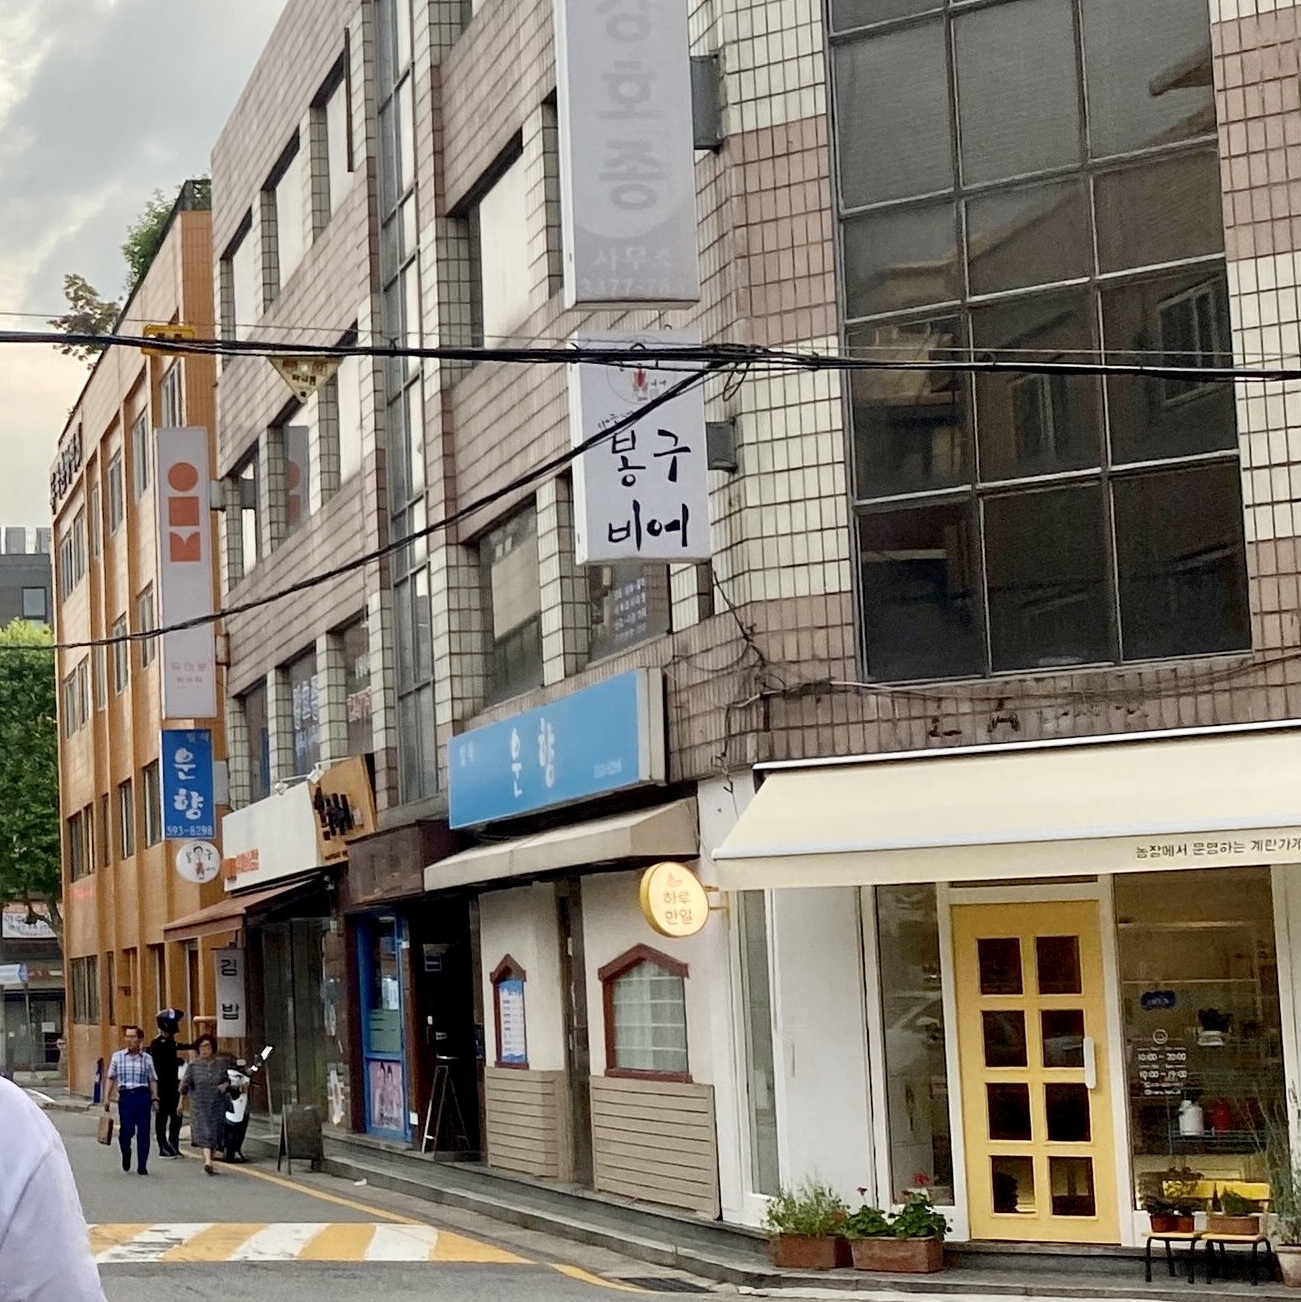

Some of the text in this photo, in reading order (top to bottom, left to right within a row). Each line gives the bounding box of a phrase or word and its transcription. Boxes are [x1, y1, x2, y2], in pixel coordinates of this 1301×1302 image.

[610, 428, 691, 488] 봉구
[1135, 844, 1188, 859] 농장에서
[662, 890, 691, 906] 하루
[664, 908, 693, 926] 한알
[220, 959, 240, 1021] 김밥
